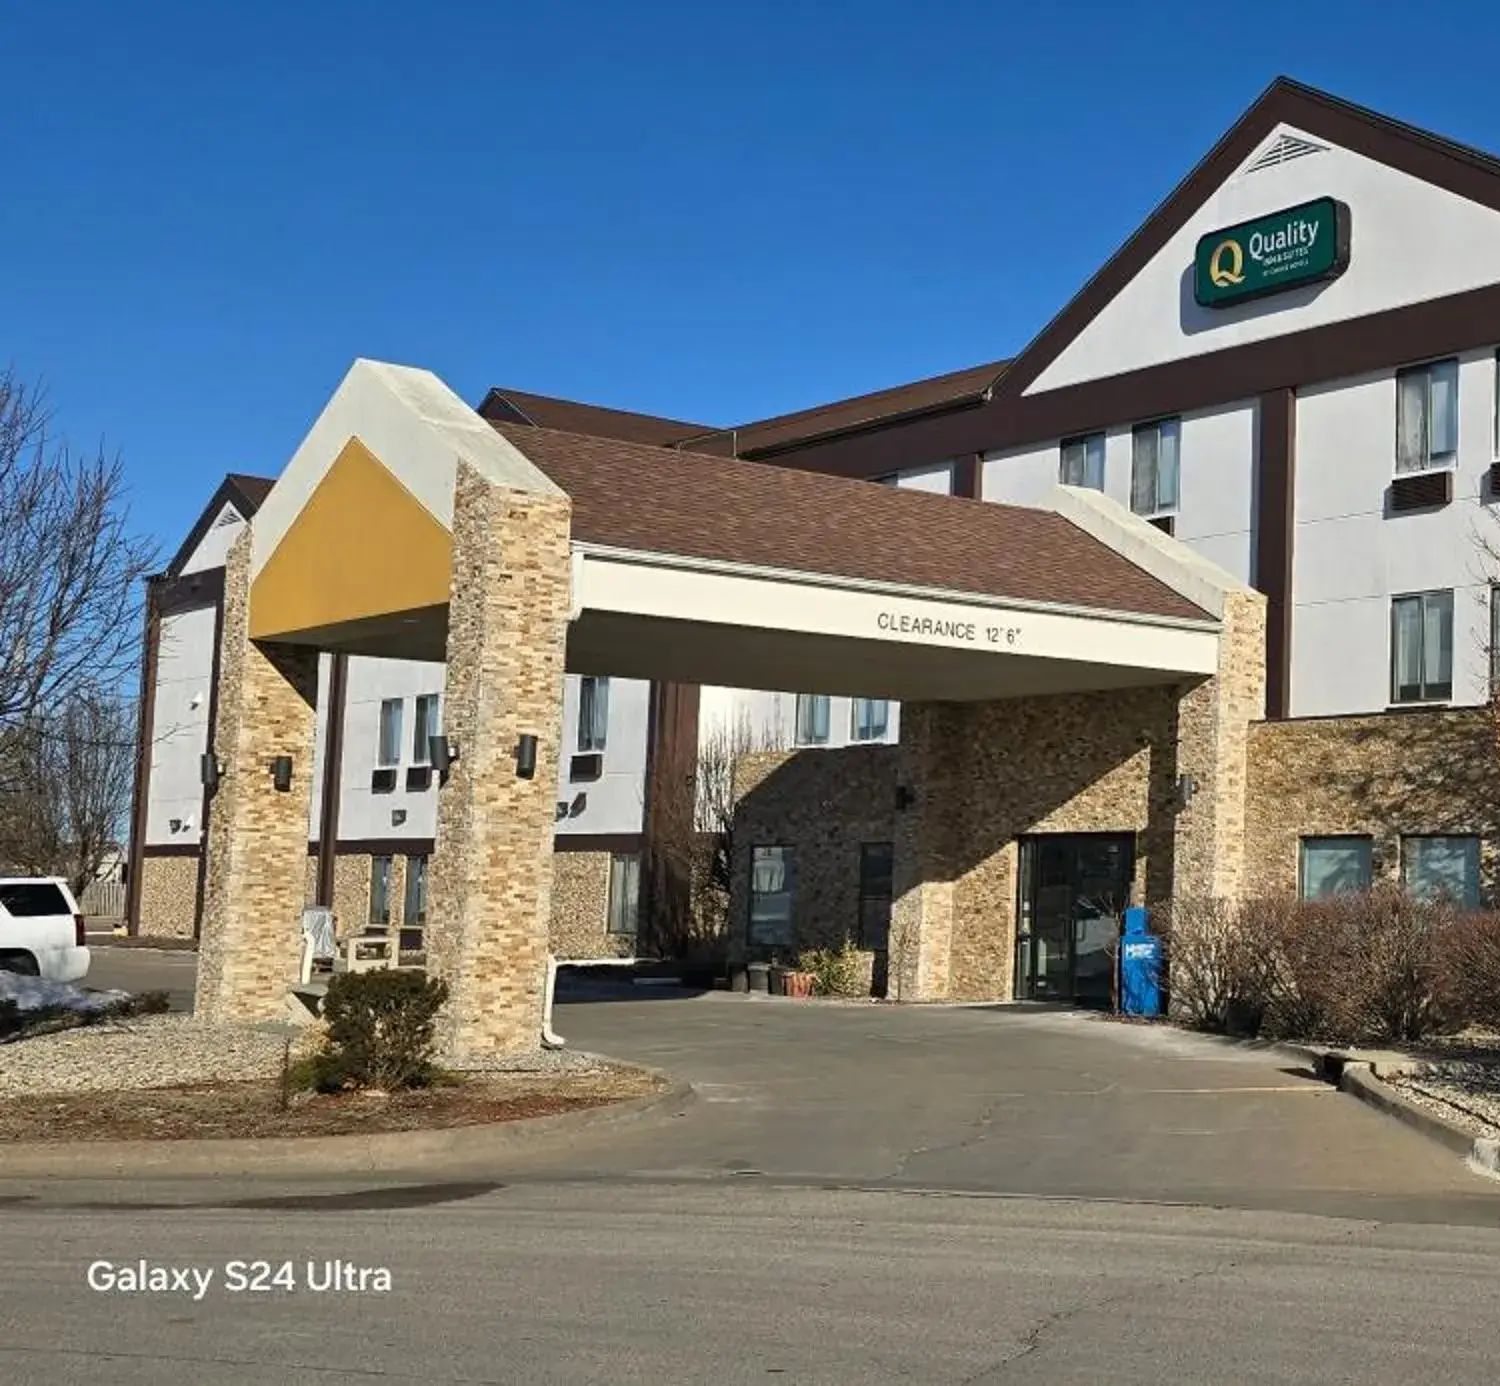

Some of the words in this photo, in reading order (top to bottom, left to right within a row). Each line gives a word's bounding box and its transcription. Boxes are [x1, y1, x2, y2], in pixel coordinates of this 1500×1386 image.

[1249, 220, 1319, 260] Quality
[1210, 239, 1246, 287] Q
[877, 612, 976, 641] CLEARANCE
